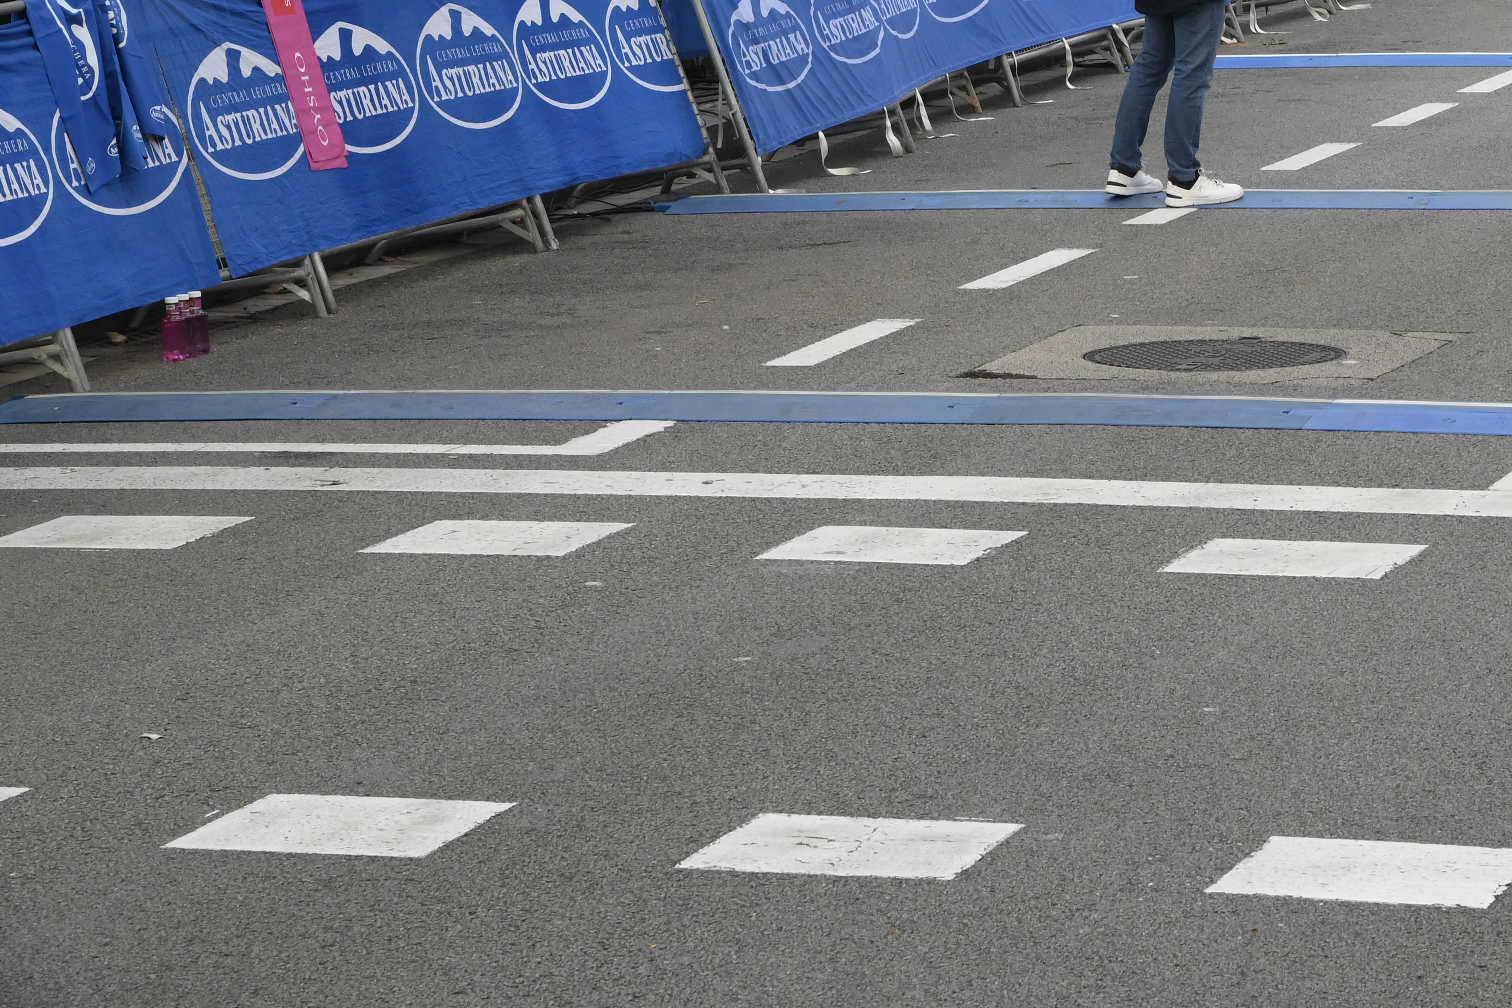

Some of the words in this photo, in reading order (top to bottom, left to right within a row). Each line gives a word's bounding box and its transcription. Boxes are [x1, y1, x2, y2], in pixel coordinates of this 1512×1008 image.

[625, 18, 657, 31] CENTRAL
[362, 61, 398, 77] LECHERA
[437, 48, 468, 61] CENTRAL
[521, 38, 607, 84] ASTURIANA
[210, 87, 248, 107] CENTRAL
[294, 52, 329, 146] OYSHO
[330, 77, 414, 124] STURIANA
[426, 54, 518, 102] ASTURIANA
[200, 101, 300, 153] ASTURIANA
